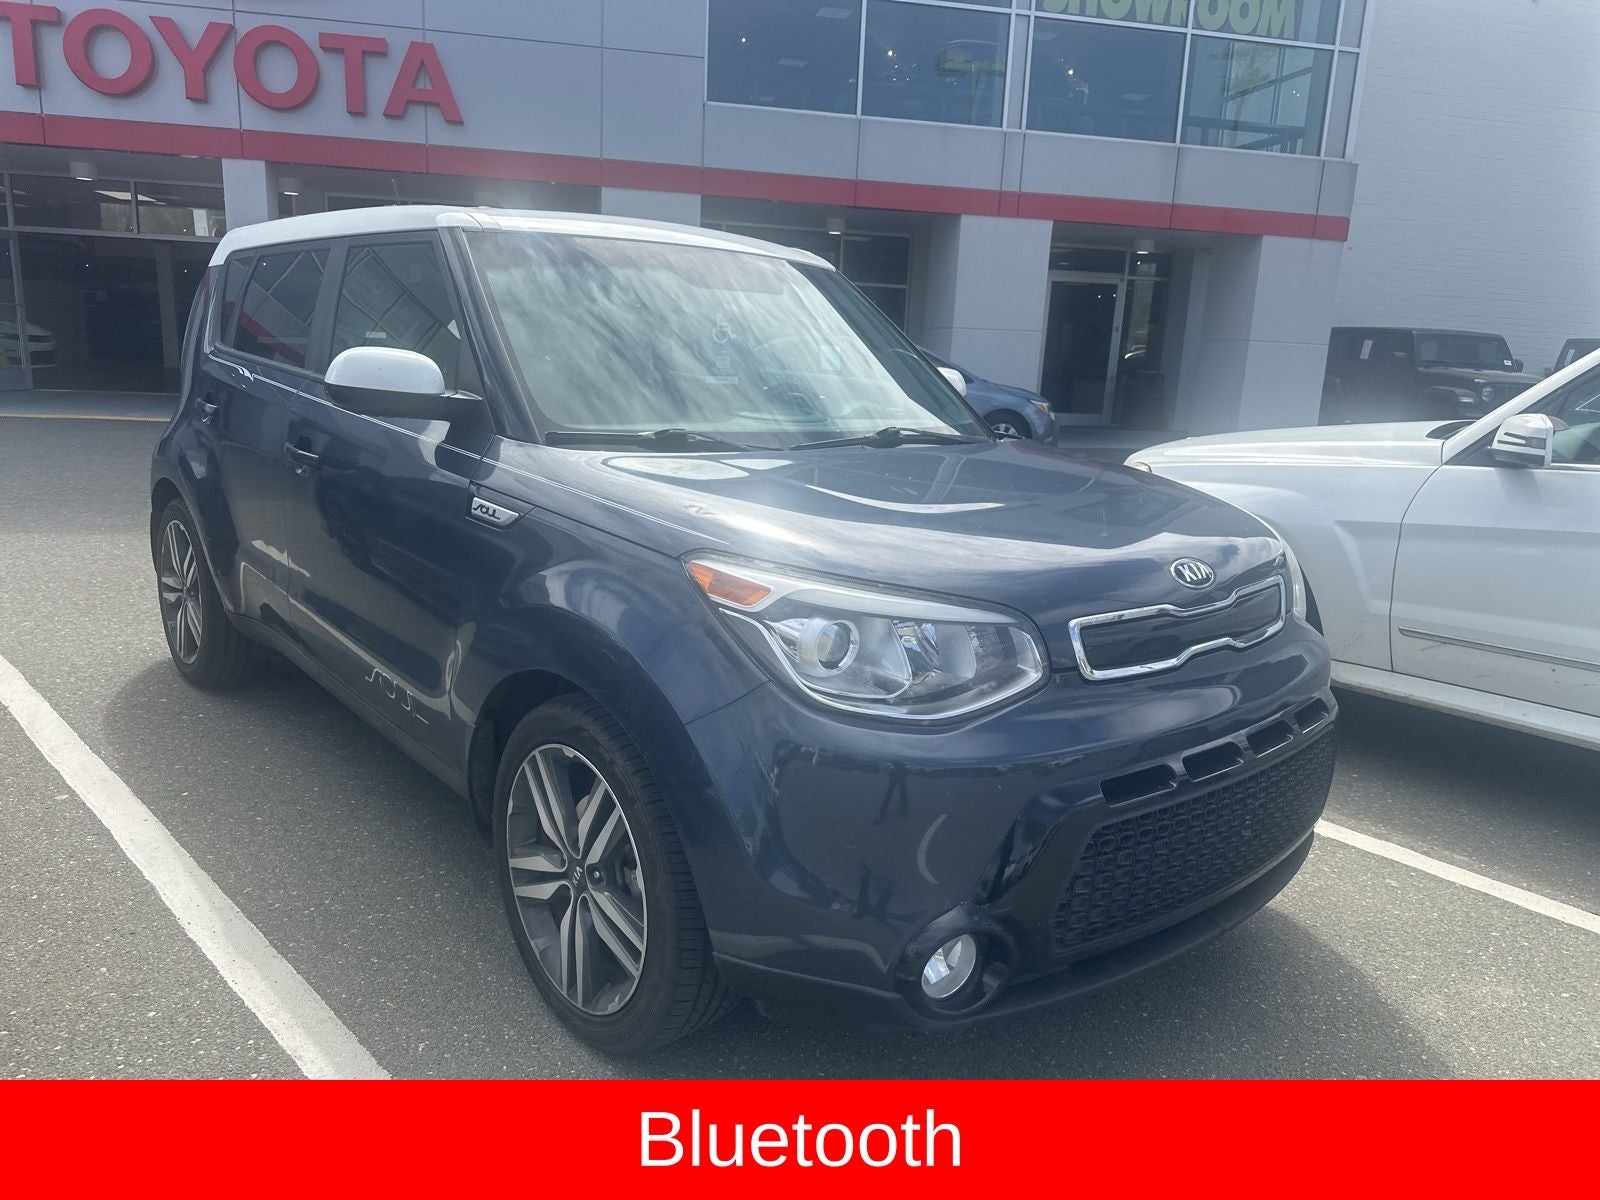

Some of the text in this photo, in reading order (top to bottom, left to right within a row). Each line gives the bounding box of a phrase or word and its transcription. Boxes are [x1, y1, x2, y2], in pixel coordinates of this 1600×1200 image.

[1042, 0, 1295, 39] WROOM
[0, 2, 464, 125] TOYOTA
[1177, 562, 1212, 582] KIA
